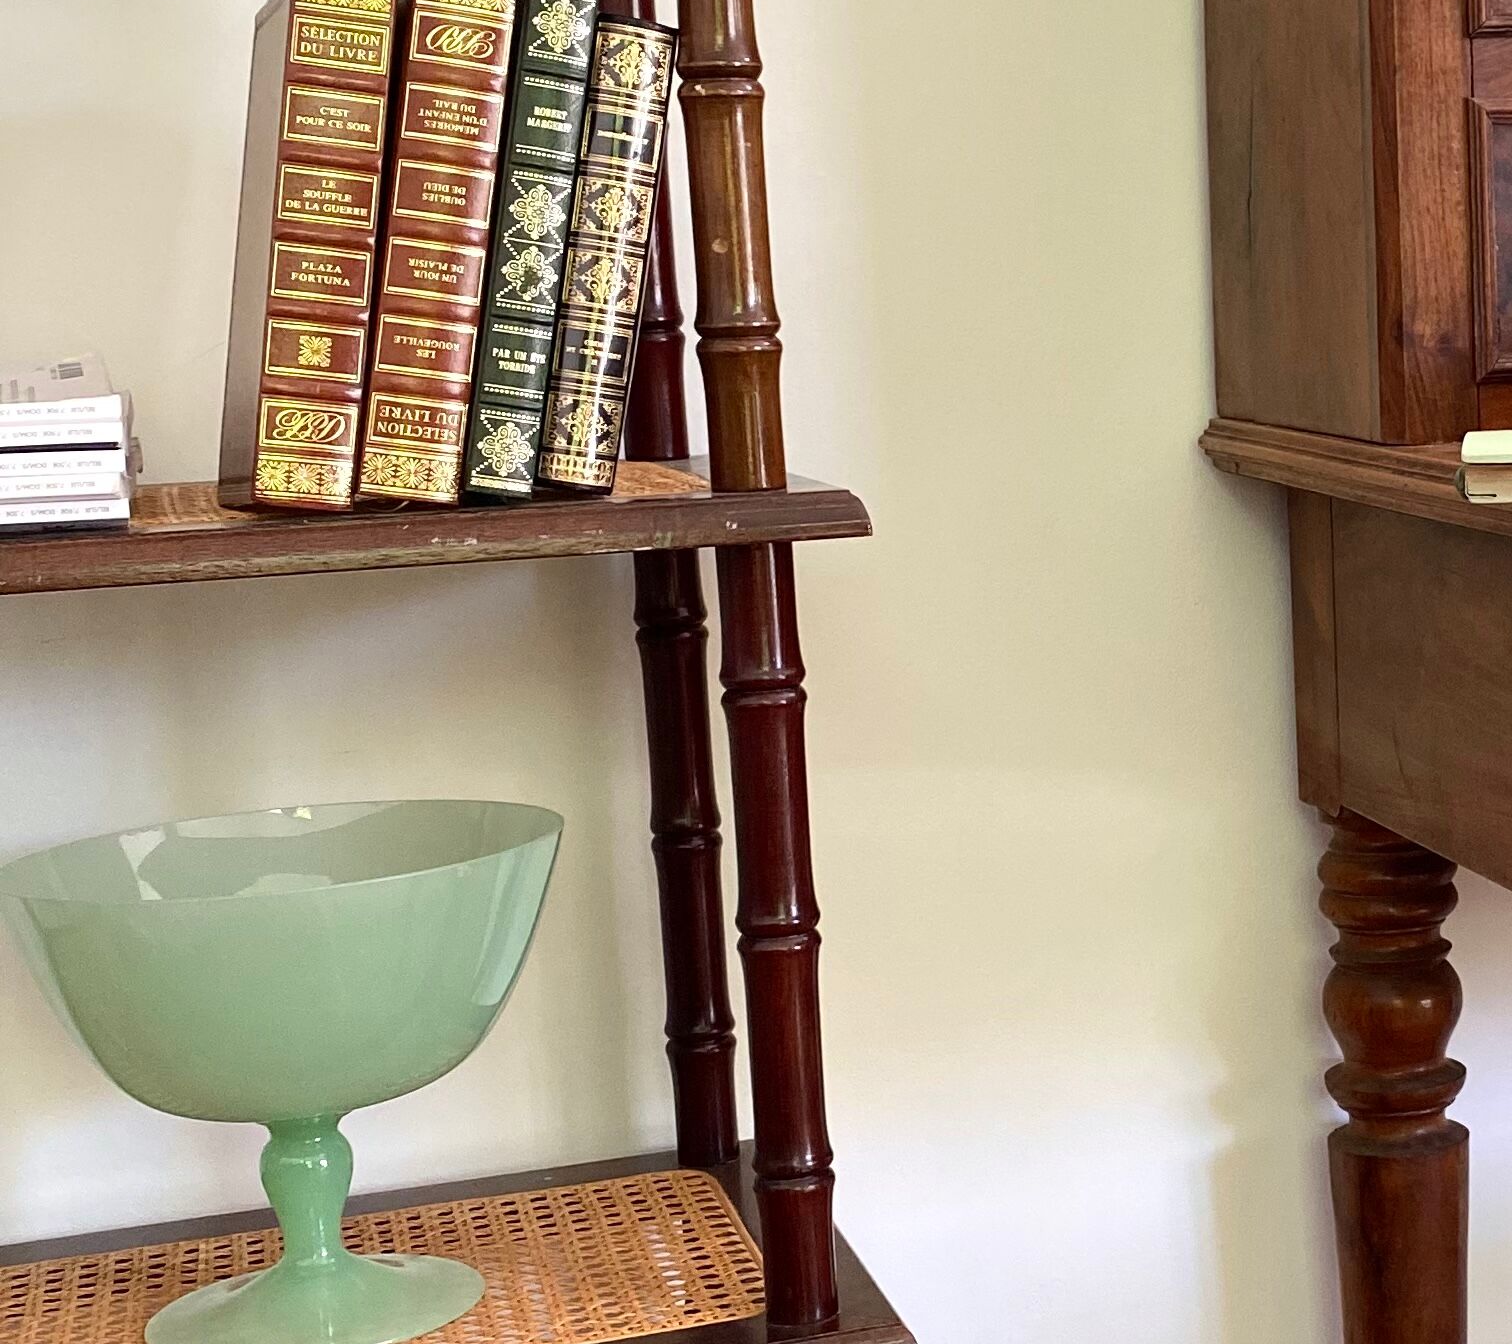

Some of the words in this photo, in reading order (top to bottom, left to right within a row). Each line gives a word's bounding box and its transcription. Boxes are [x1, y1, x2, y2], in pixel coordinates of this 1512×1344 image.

[300, 41, 322, 55] DU
[329, 45, 379, 62] LIVRE
[432, 99, 458, 112] RAIL
[460, 103, 476, 114] DU
[417, 108, 461, 122] ENFANT
[295, 115, 325, 128] POUR
[328, 119, 343, 130] CE
[345, 121, 371, 133] SOIR
[321, 179, 336, 190] LE
[422, 181, 450, 194] DIEU
[451, 185, 467, 196] DE
[302, 190, 352, 203] SOUFFLE
[285, 199, 301, 209] DE
[305, 201, 319, 212] LA
[323, 204, 369, 217] GUERRE
[301, 261, 342, 274] PLAZA
[407, 257, 449, 271] PLAISIR
[450, 263, 465, 274] DE
[290, 271, 351, 287] FORTUNA
[441, 273, 457, 284] UN
[393, 335, 460, 352] ROUGEVILLE
[416, 348, 436, 360] LES
[492, 347, 511, 359] PAR
[514, 350, 527, 361] UN
[379, 405, 431, 423] LIVRE
[434, 412, 459, 426] DU
